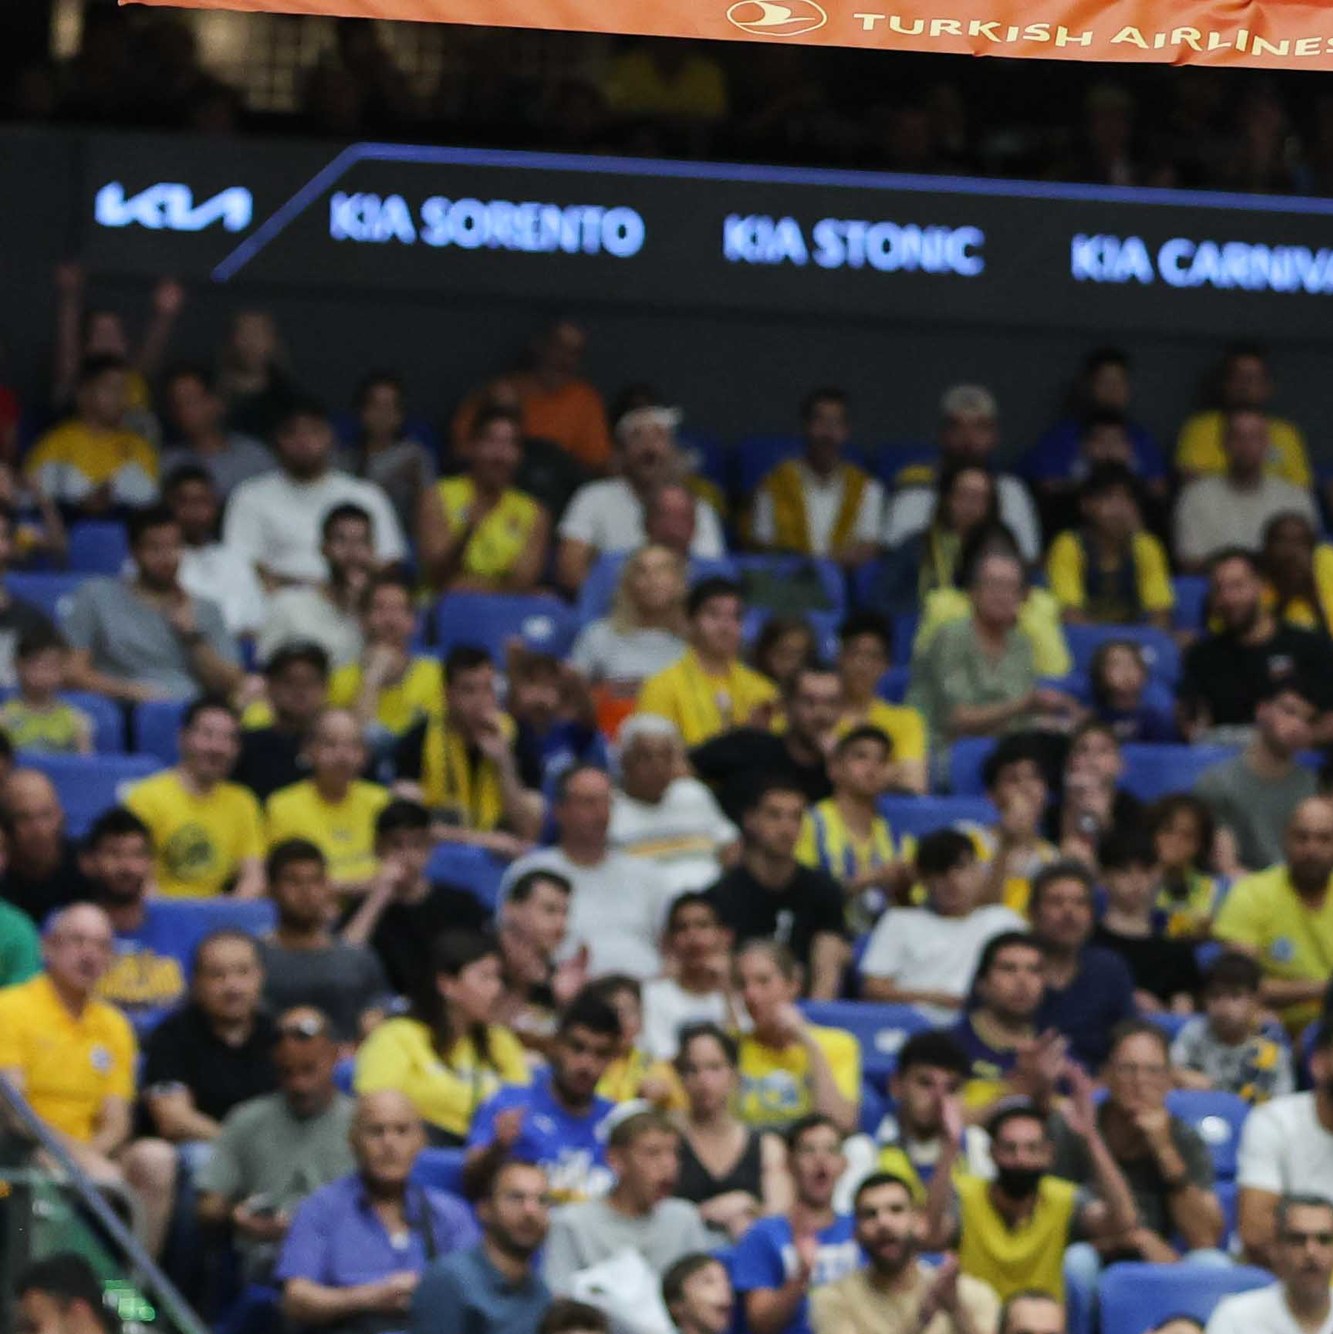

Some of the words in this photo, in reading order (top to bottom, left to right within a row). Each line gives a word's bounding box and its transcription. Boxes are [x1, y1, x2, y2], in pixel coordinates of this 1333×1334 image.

[853, 12, 1094, 49] TURKISH
[330, 191, 416, 245] KIA
[420, 195, 646, 258] SORENTO
[723, 214, 808, 264] KIA
[812, 219, 985, 278] STONIC
[1070, 233, 1153, 283] KIA
